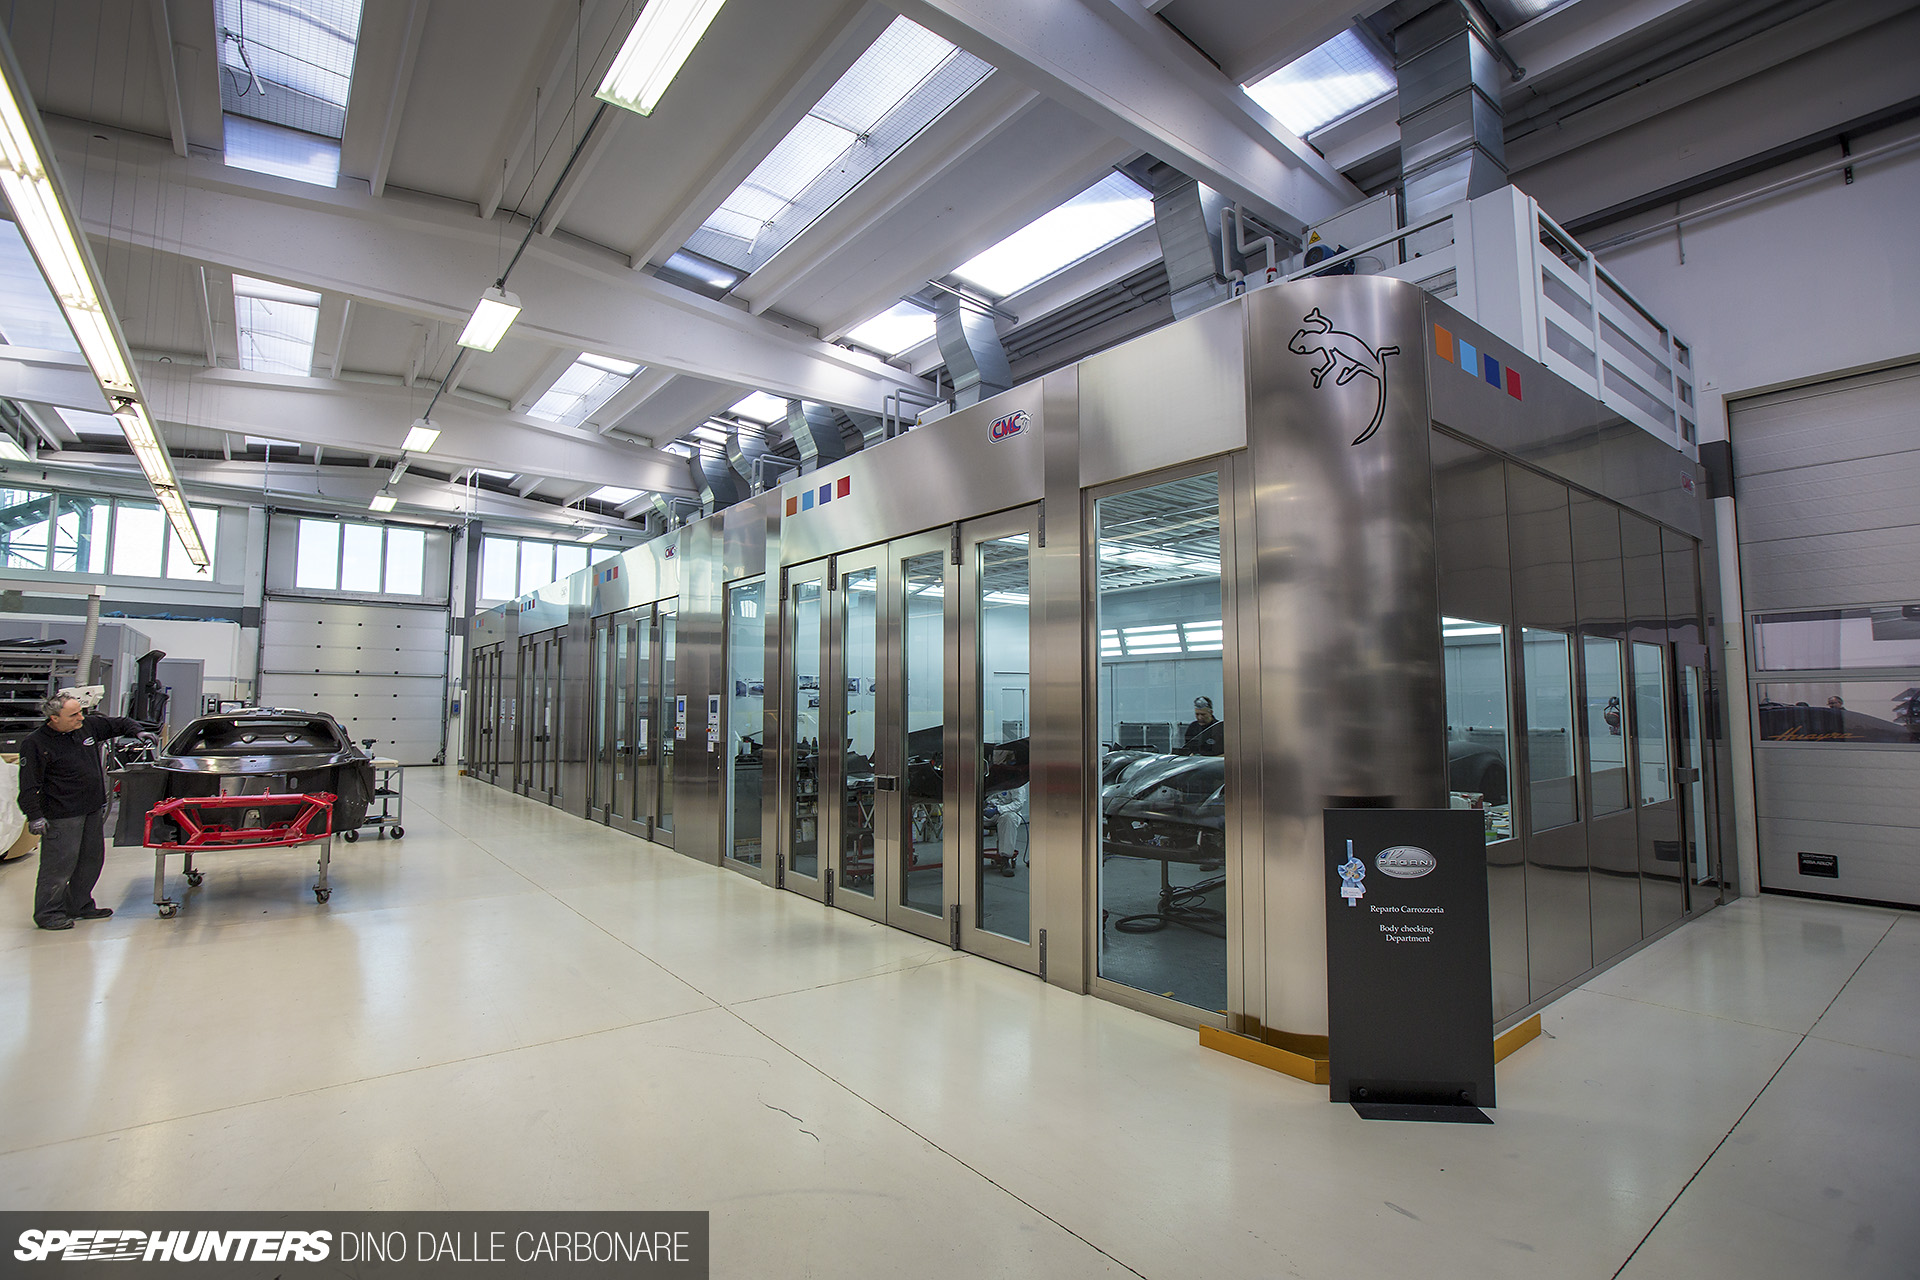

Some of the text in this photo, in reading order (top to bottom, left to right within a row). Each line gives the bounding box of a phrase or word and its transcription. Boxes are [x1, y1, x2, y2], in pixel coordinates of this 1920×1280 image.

[992, 413, 1021, 439] CMC
[1768, 725, 1864, 742] Huayra
[1370, 905, 1445, 914] Reparto Carrozzeria
[1379, 924, 1434, 935] Body checking
[1385, 934, 1431, 944] Department
